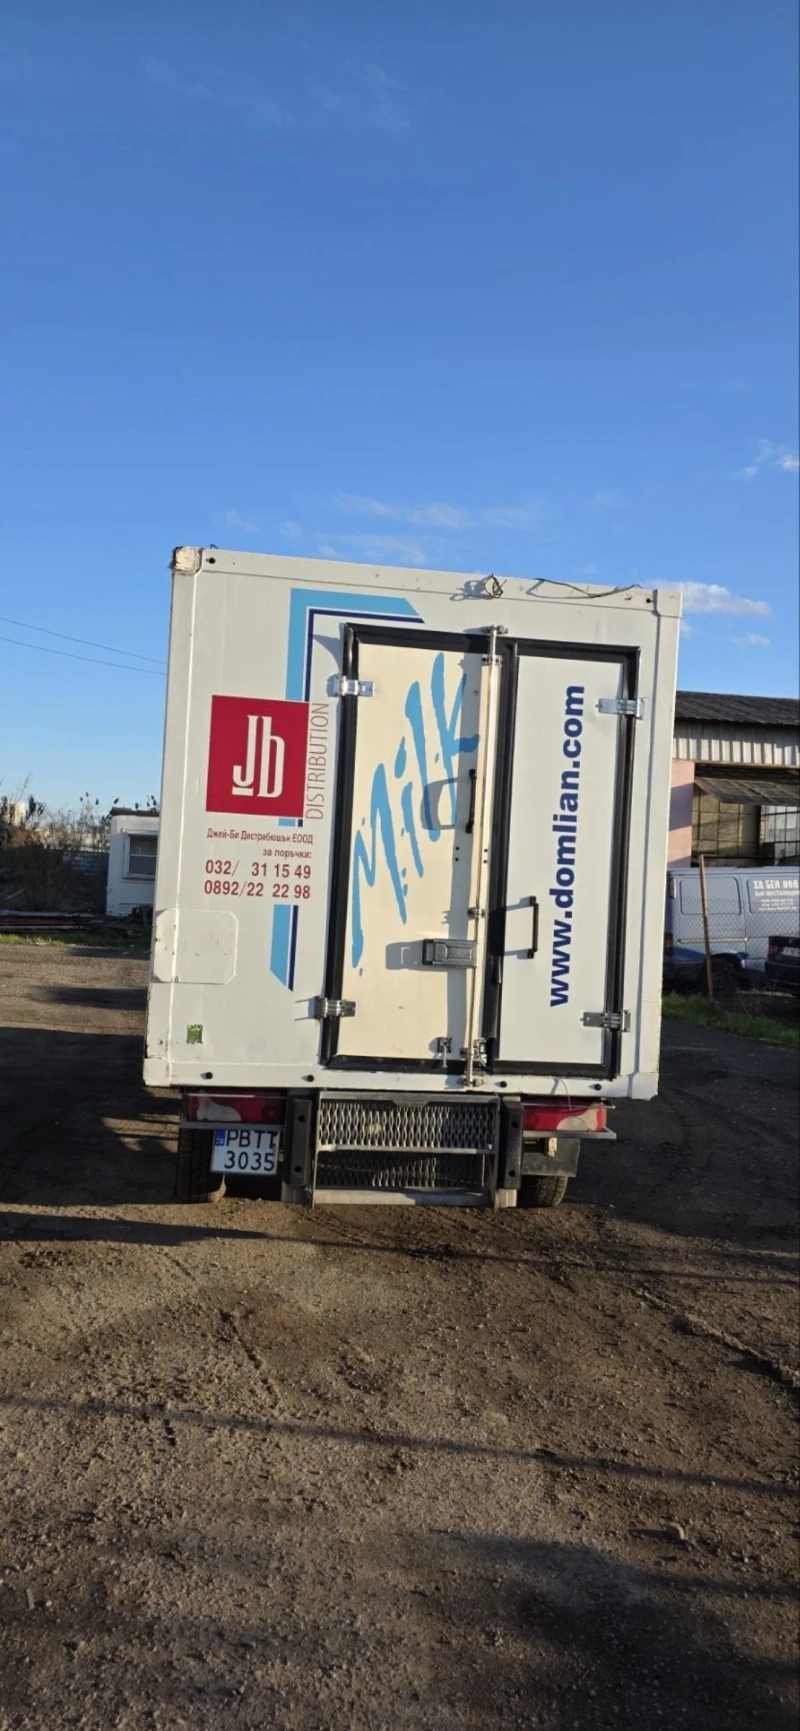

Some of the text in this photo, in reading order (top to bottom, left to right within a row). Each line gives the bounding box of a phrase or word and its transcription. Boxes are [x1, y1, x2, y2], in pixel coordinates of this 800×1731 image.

[305, 702, 330, 820] DISTRIBUTION
[292, 833, 314, 845] ЕООД
[549, 685, 585, 1007] www.domlian.com
[262, 848, 312, 860] за поръчки:
[205, 859, 311, 879] 032/ 31 15 49
[204, 879, 311, 899] 0892/22 22 98
[224, 1150, 275, 1172] 3035
